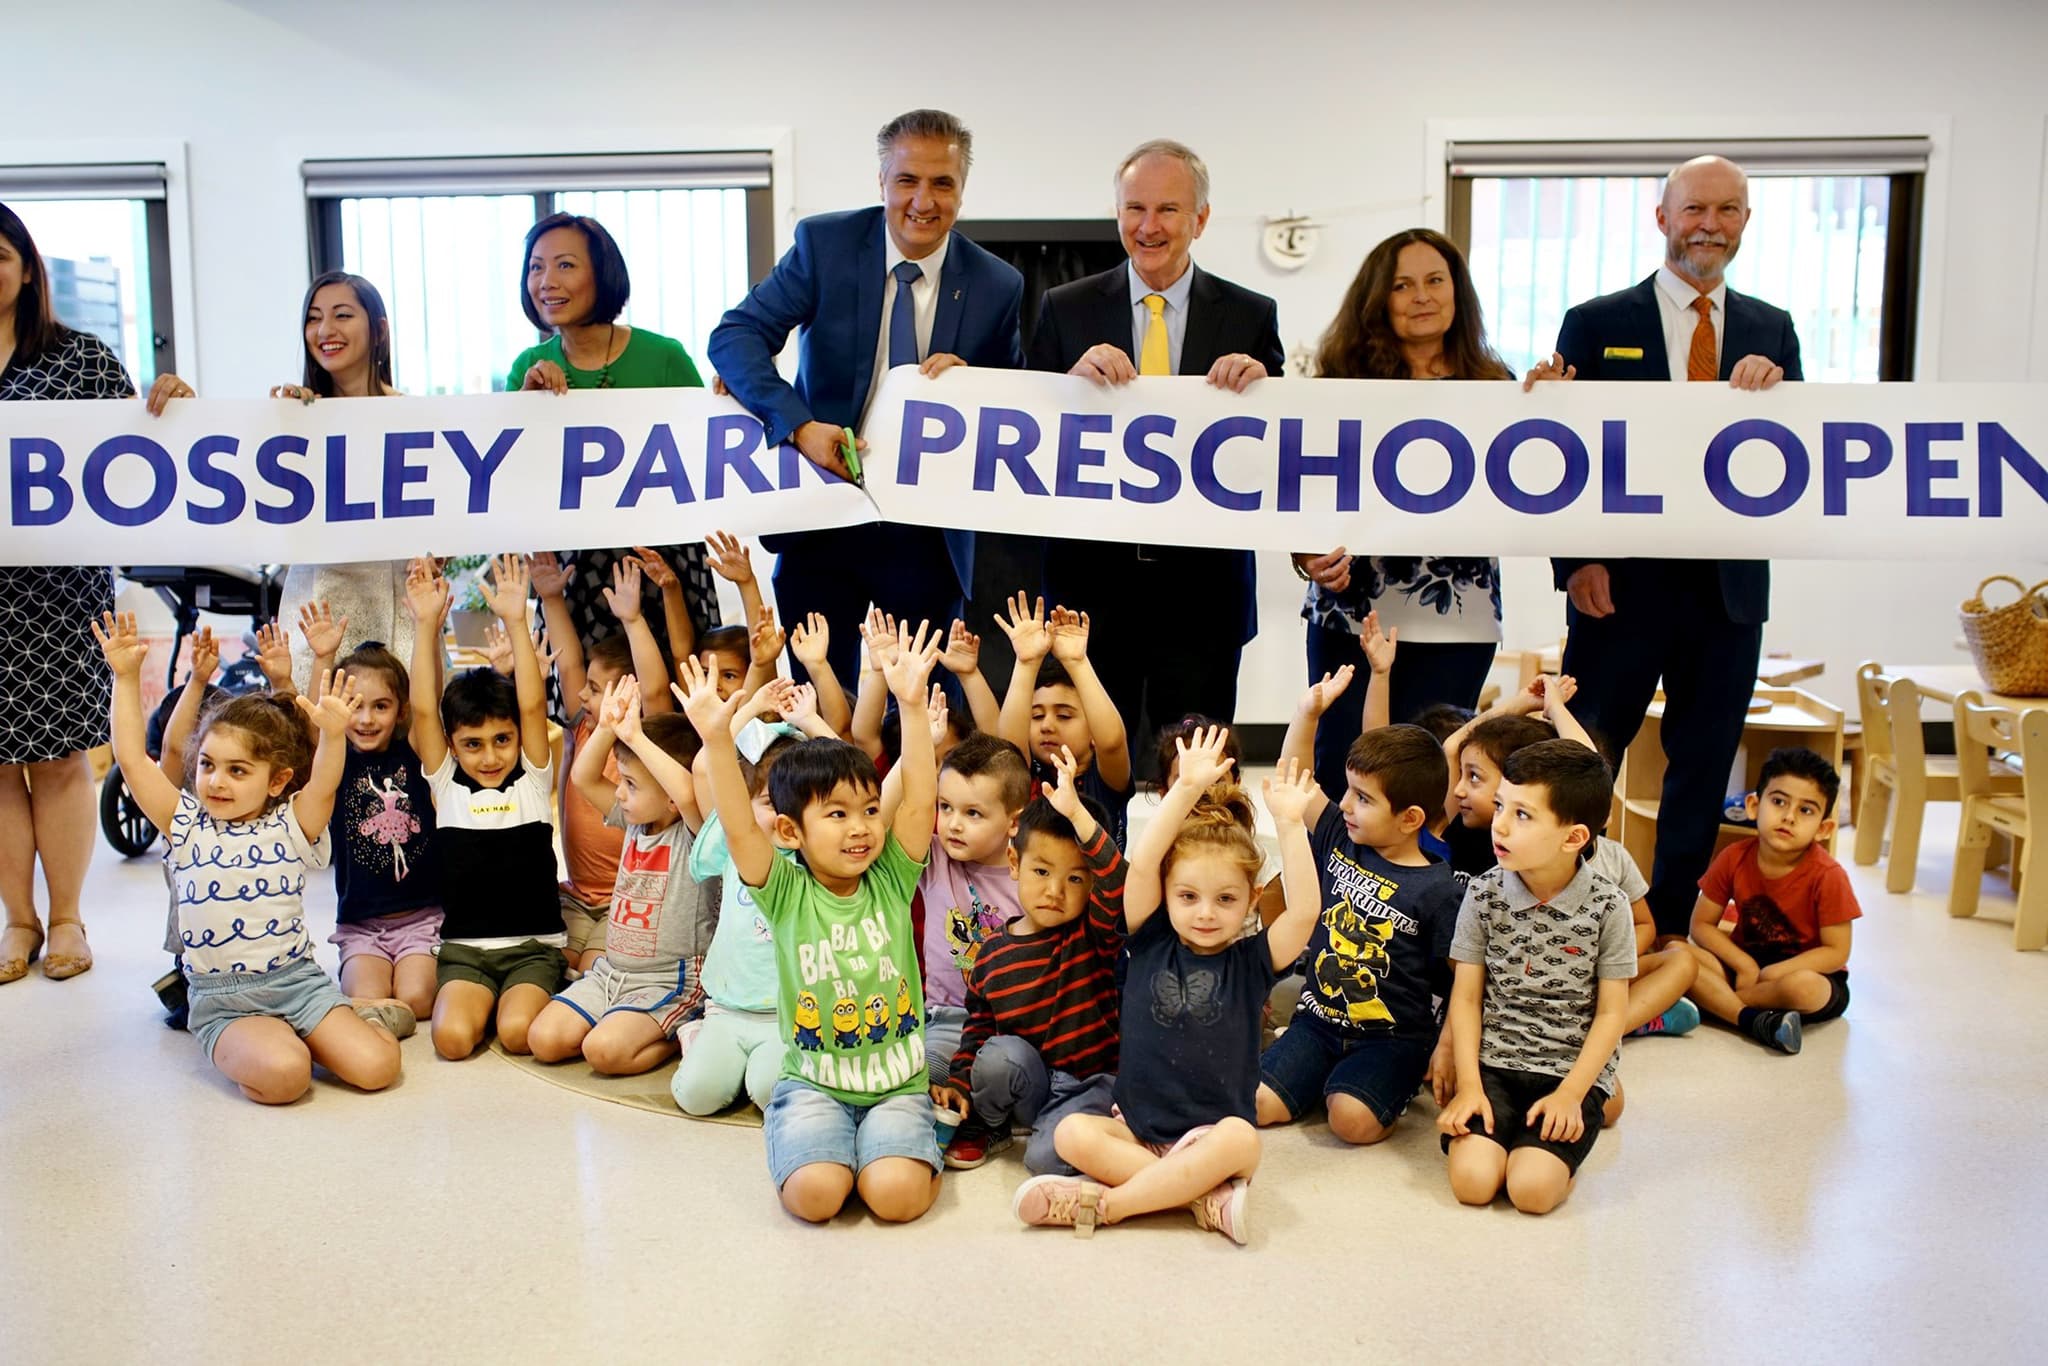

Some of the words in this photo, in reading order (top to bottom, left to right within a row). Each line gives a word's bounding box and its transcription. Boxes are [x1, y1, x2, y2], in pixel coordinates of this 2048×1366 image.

[11, 428, 522, 528] BOSSLEY
[896, 399, 1663, 514] PRESCHOOL
[1704, 420, 2048, 518] OPEN
[1327, 853, 1381, 896] TRANS
[799, 938, 841, 986] BA
[831, 923, 859, 952] BA
[847, 955, 868, 972] BA
[879, 955, 900, 983] BA
[831, 979, 859, 999] BA
